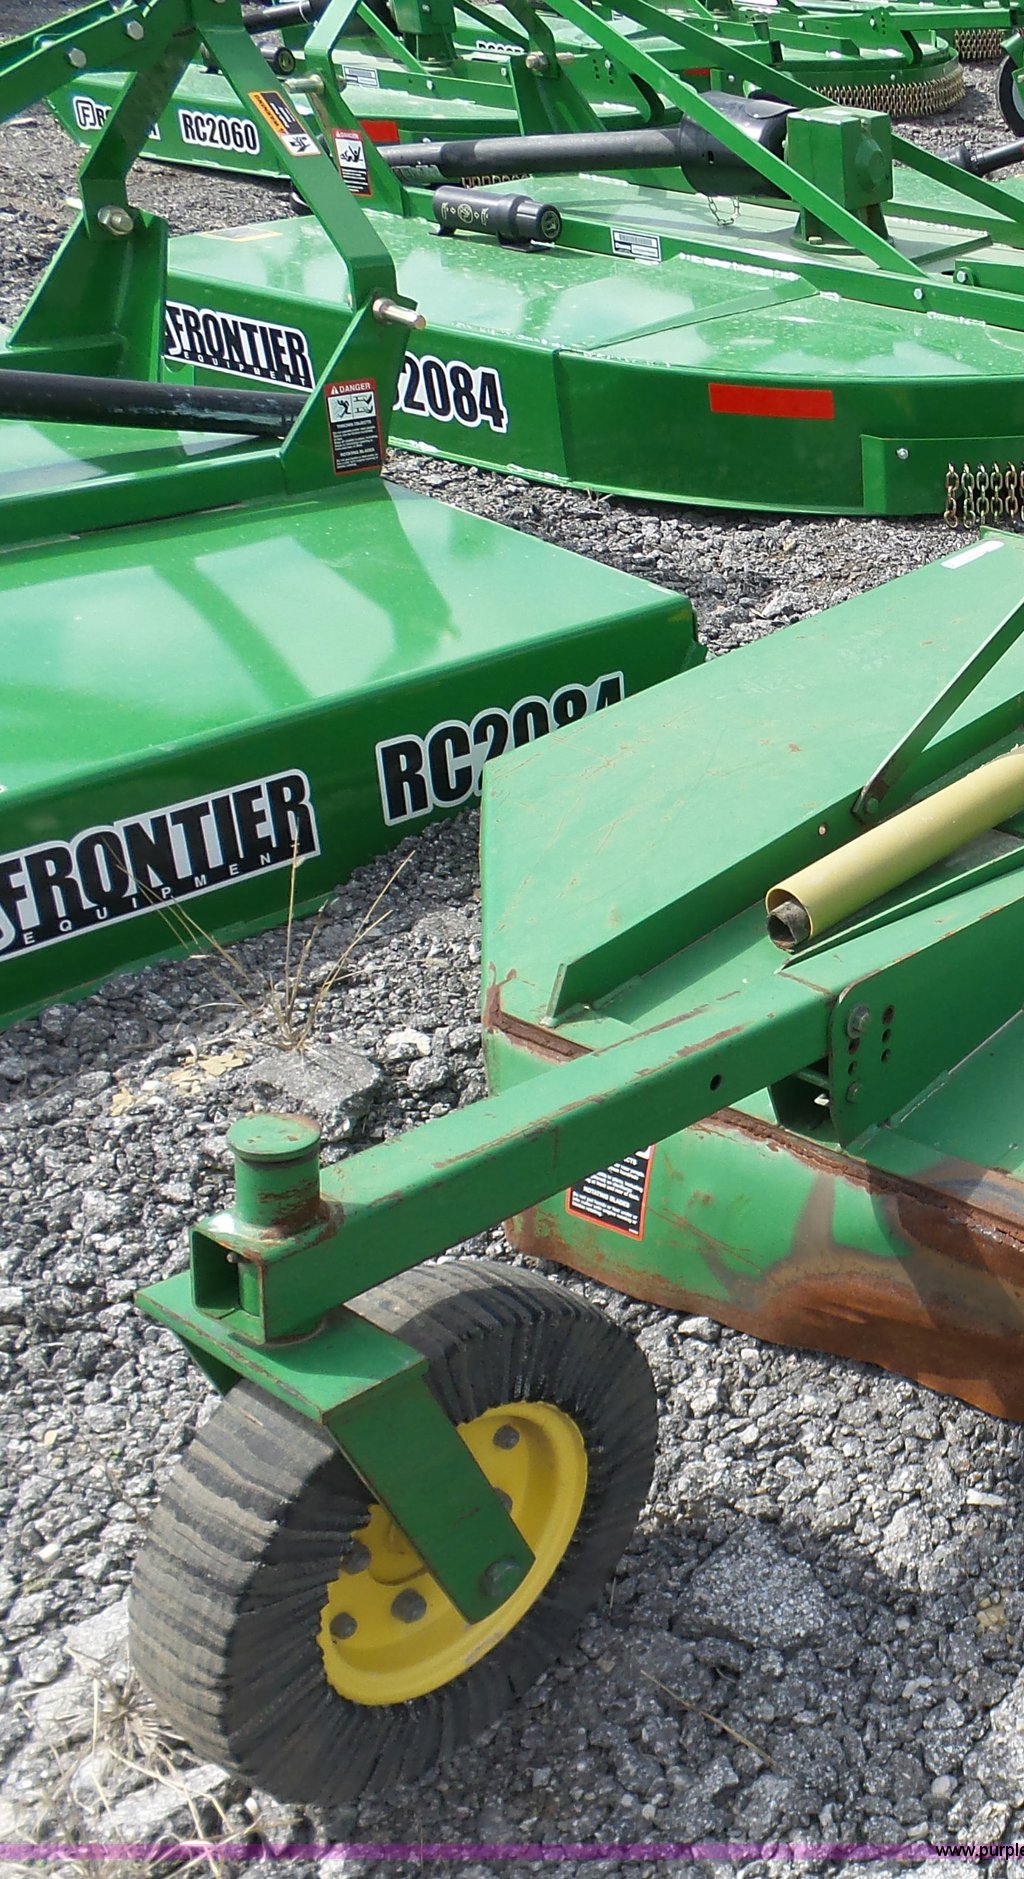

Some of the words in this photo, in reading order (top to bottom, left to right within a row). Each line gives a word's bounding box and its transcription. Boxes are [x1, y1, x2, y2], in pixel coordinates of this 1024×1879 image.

[180, 111, 259, 152] RC2060
[164, 304, 314, 380] FRONTIER
[184, 351, 306, 386] EQUIPMENT
[339, 382, 371, 393] DANGER
[397, 354, 505, 429] 2084
[0, 774, 317, 932] FRONTIER
[23, 842, 301, 945] EQUIPMENT
